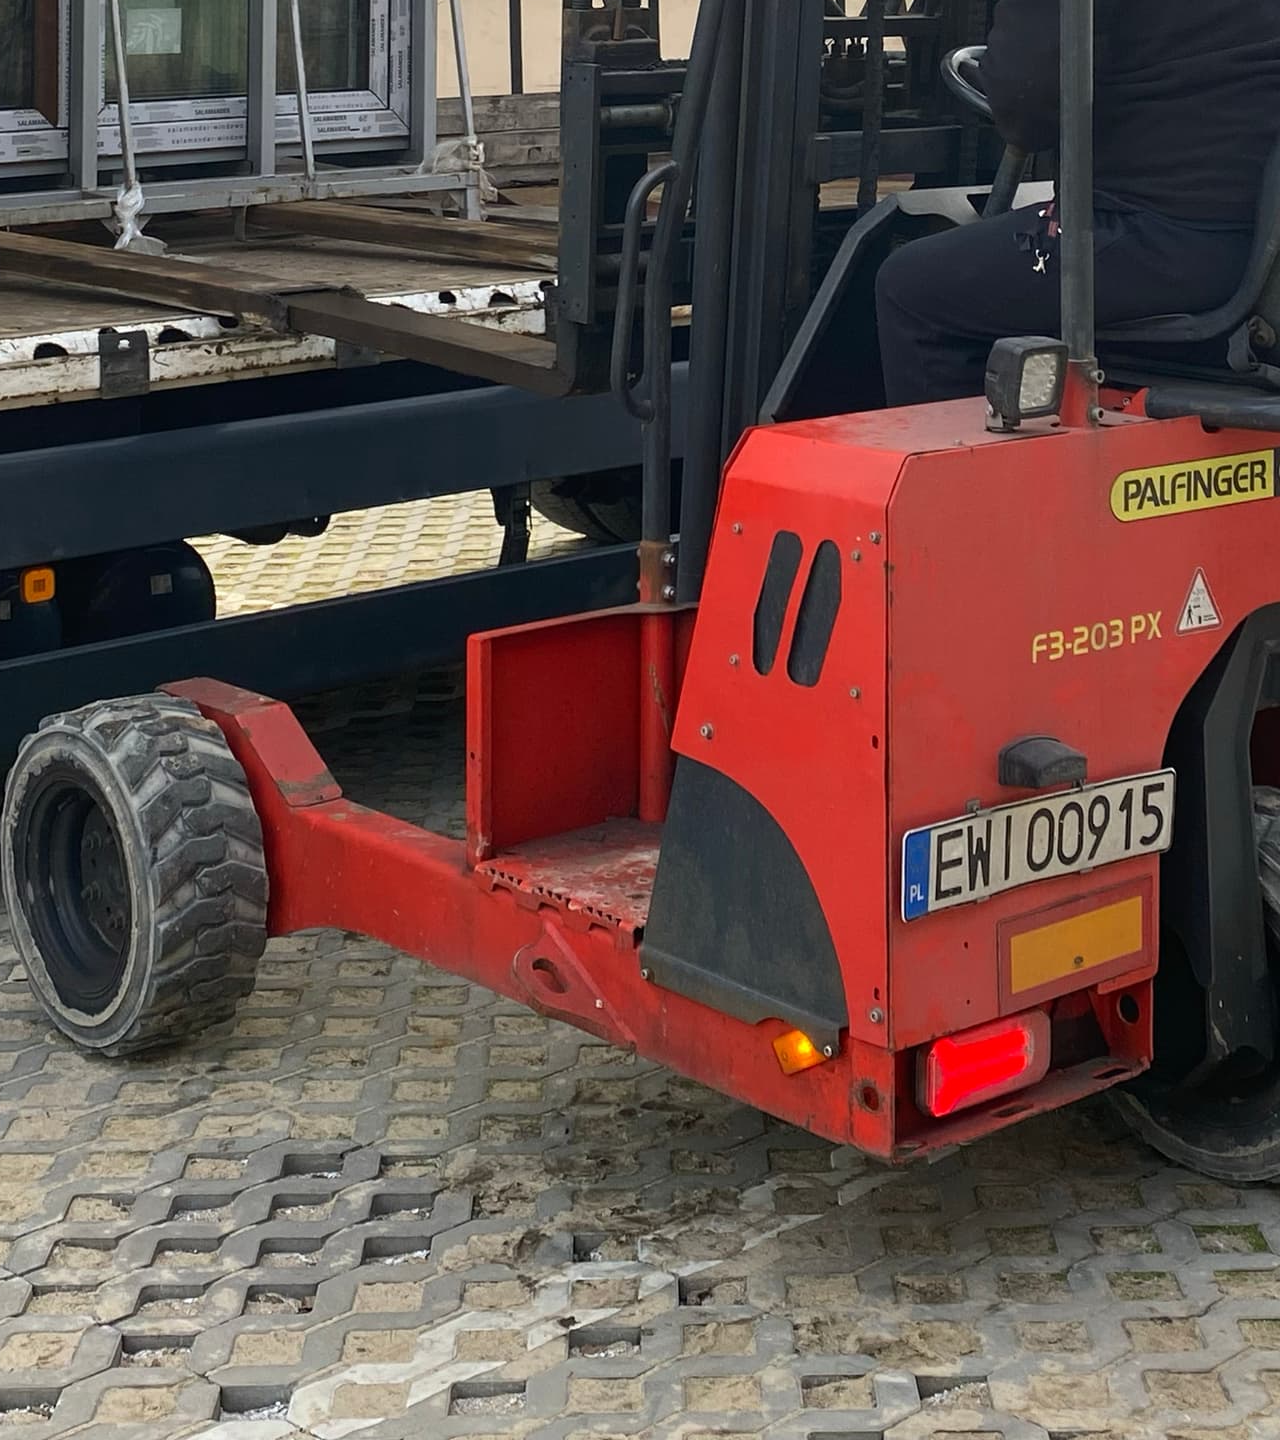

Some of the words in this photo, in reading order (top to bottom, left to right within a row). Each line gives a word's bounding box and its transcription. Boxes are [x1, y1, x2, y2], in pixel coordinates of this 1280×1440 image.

[1123, 460, 1267, 512] PALFINGER
[1031, 618, 1124, 664] F3-203
[1131, 611, 1162, 644] PX
[909, 884, 924, 904] PL
